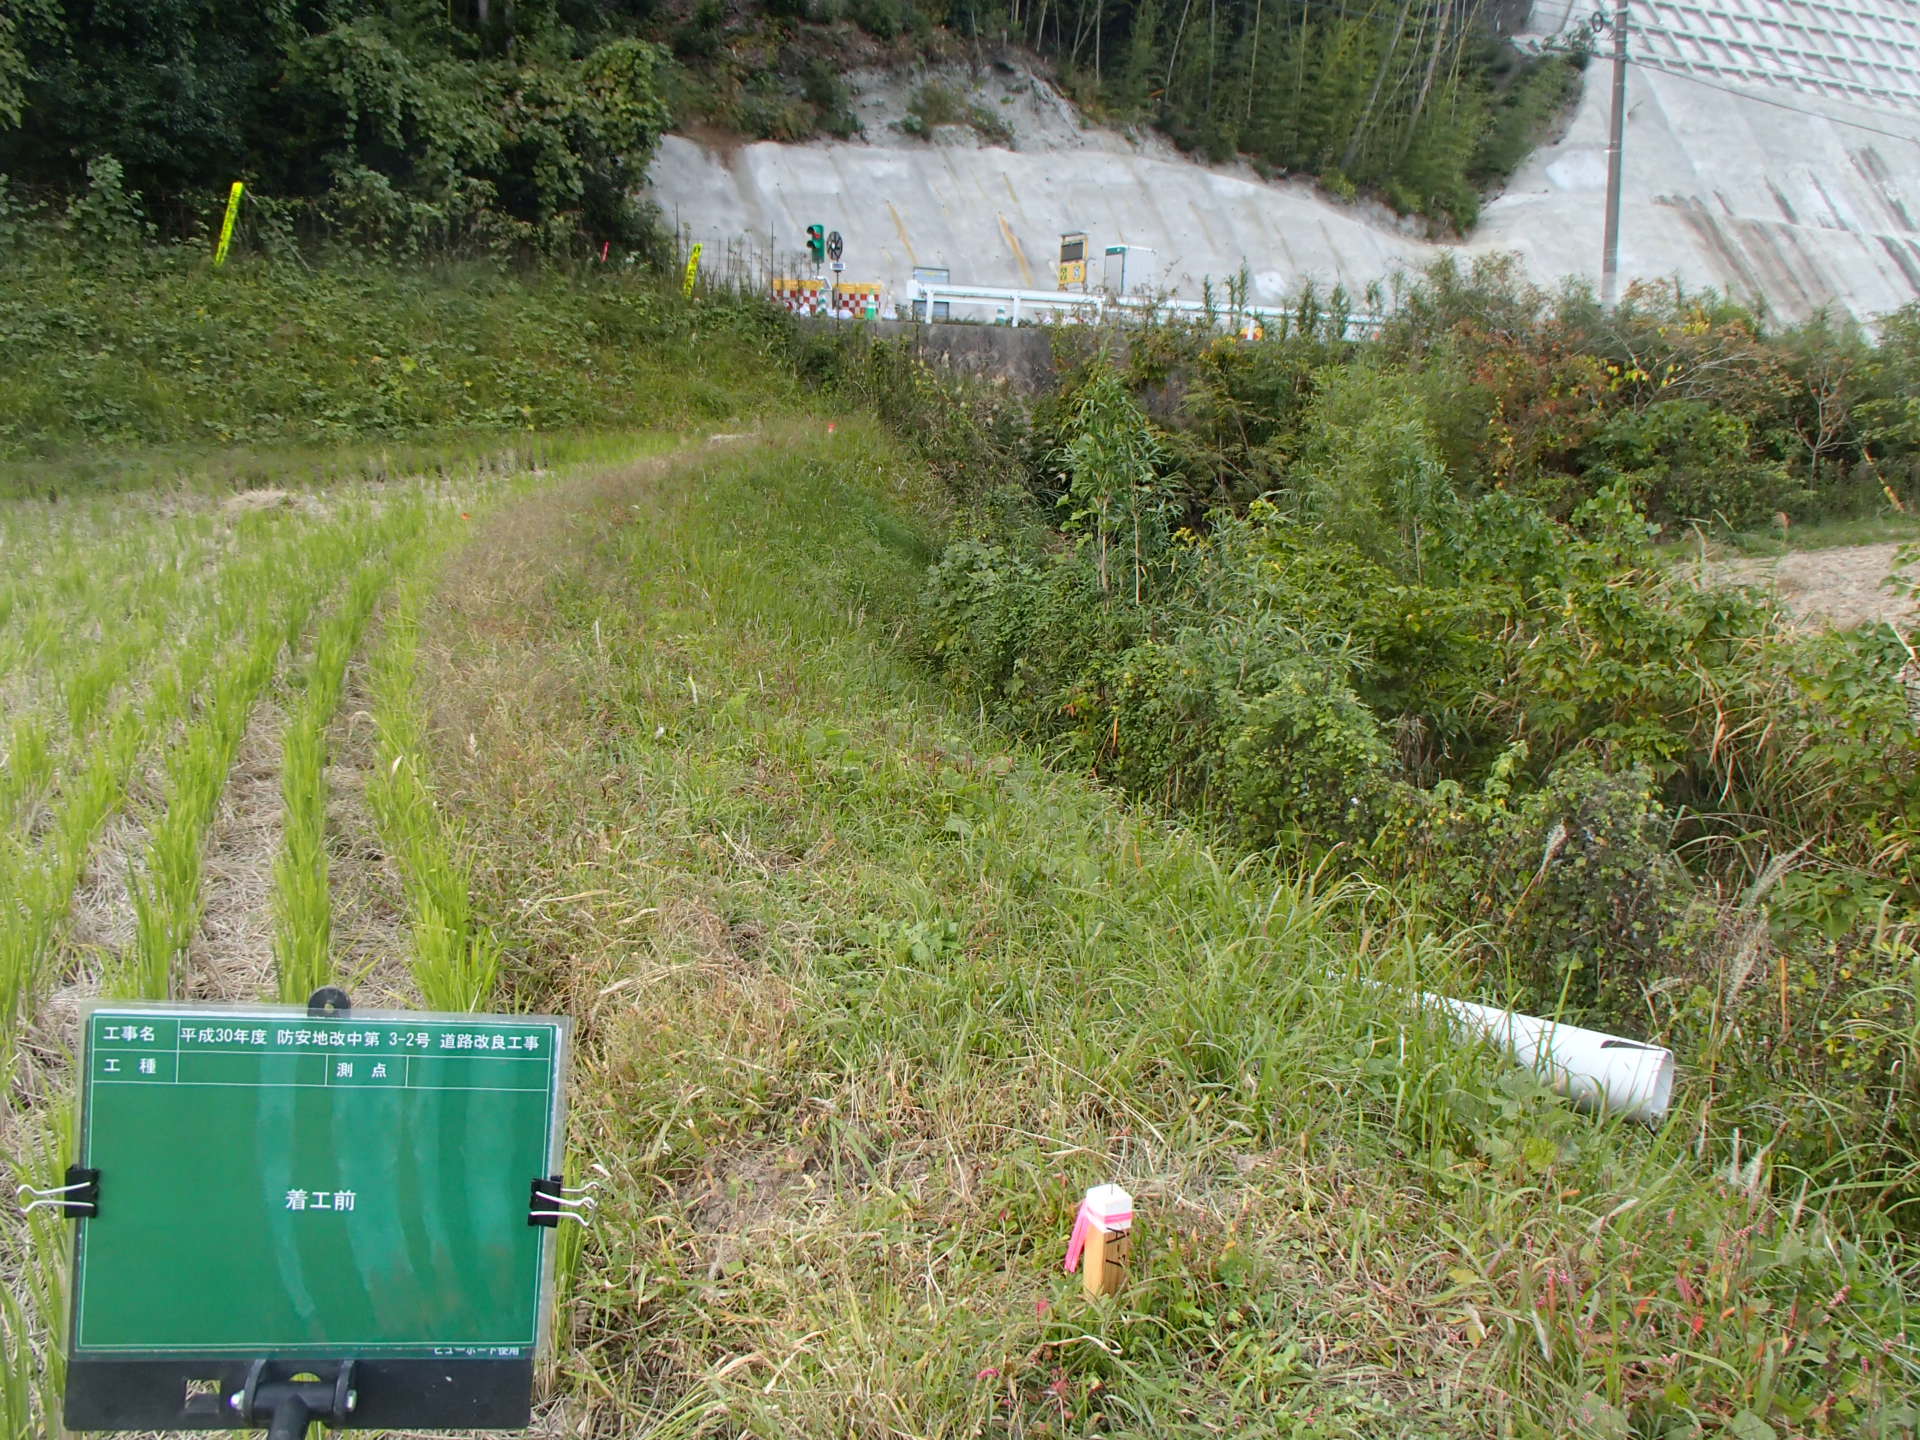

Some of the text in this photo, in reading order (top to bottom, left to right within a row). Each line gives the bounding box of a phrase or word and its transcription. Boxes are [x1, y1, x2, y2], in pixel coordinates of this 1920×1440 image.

[103, 1025, 155, 1042] 工事名
[180, 1027, 540, 1051] 平成30年度 防安地改中第 3-2号 道路改良工事
[285, 1188, 357, 1211] 着工前
